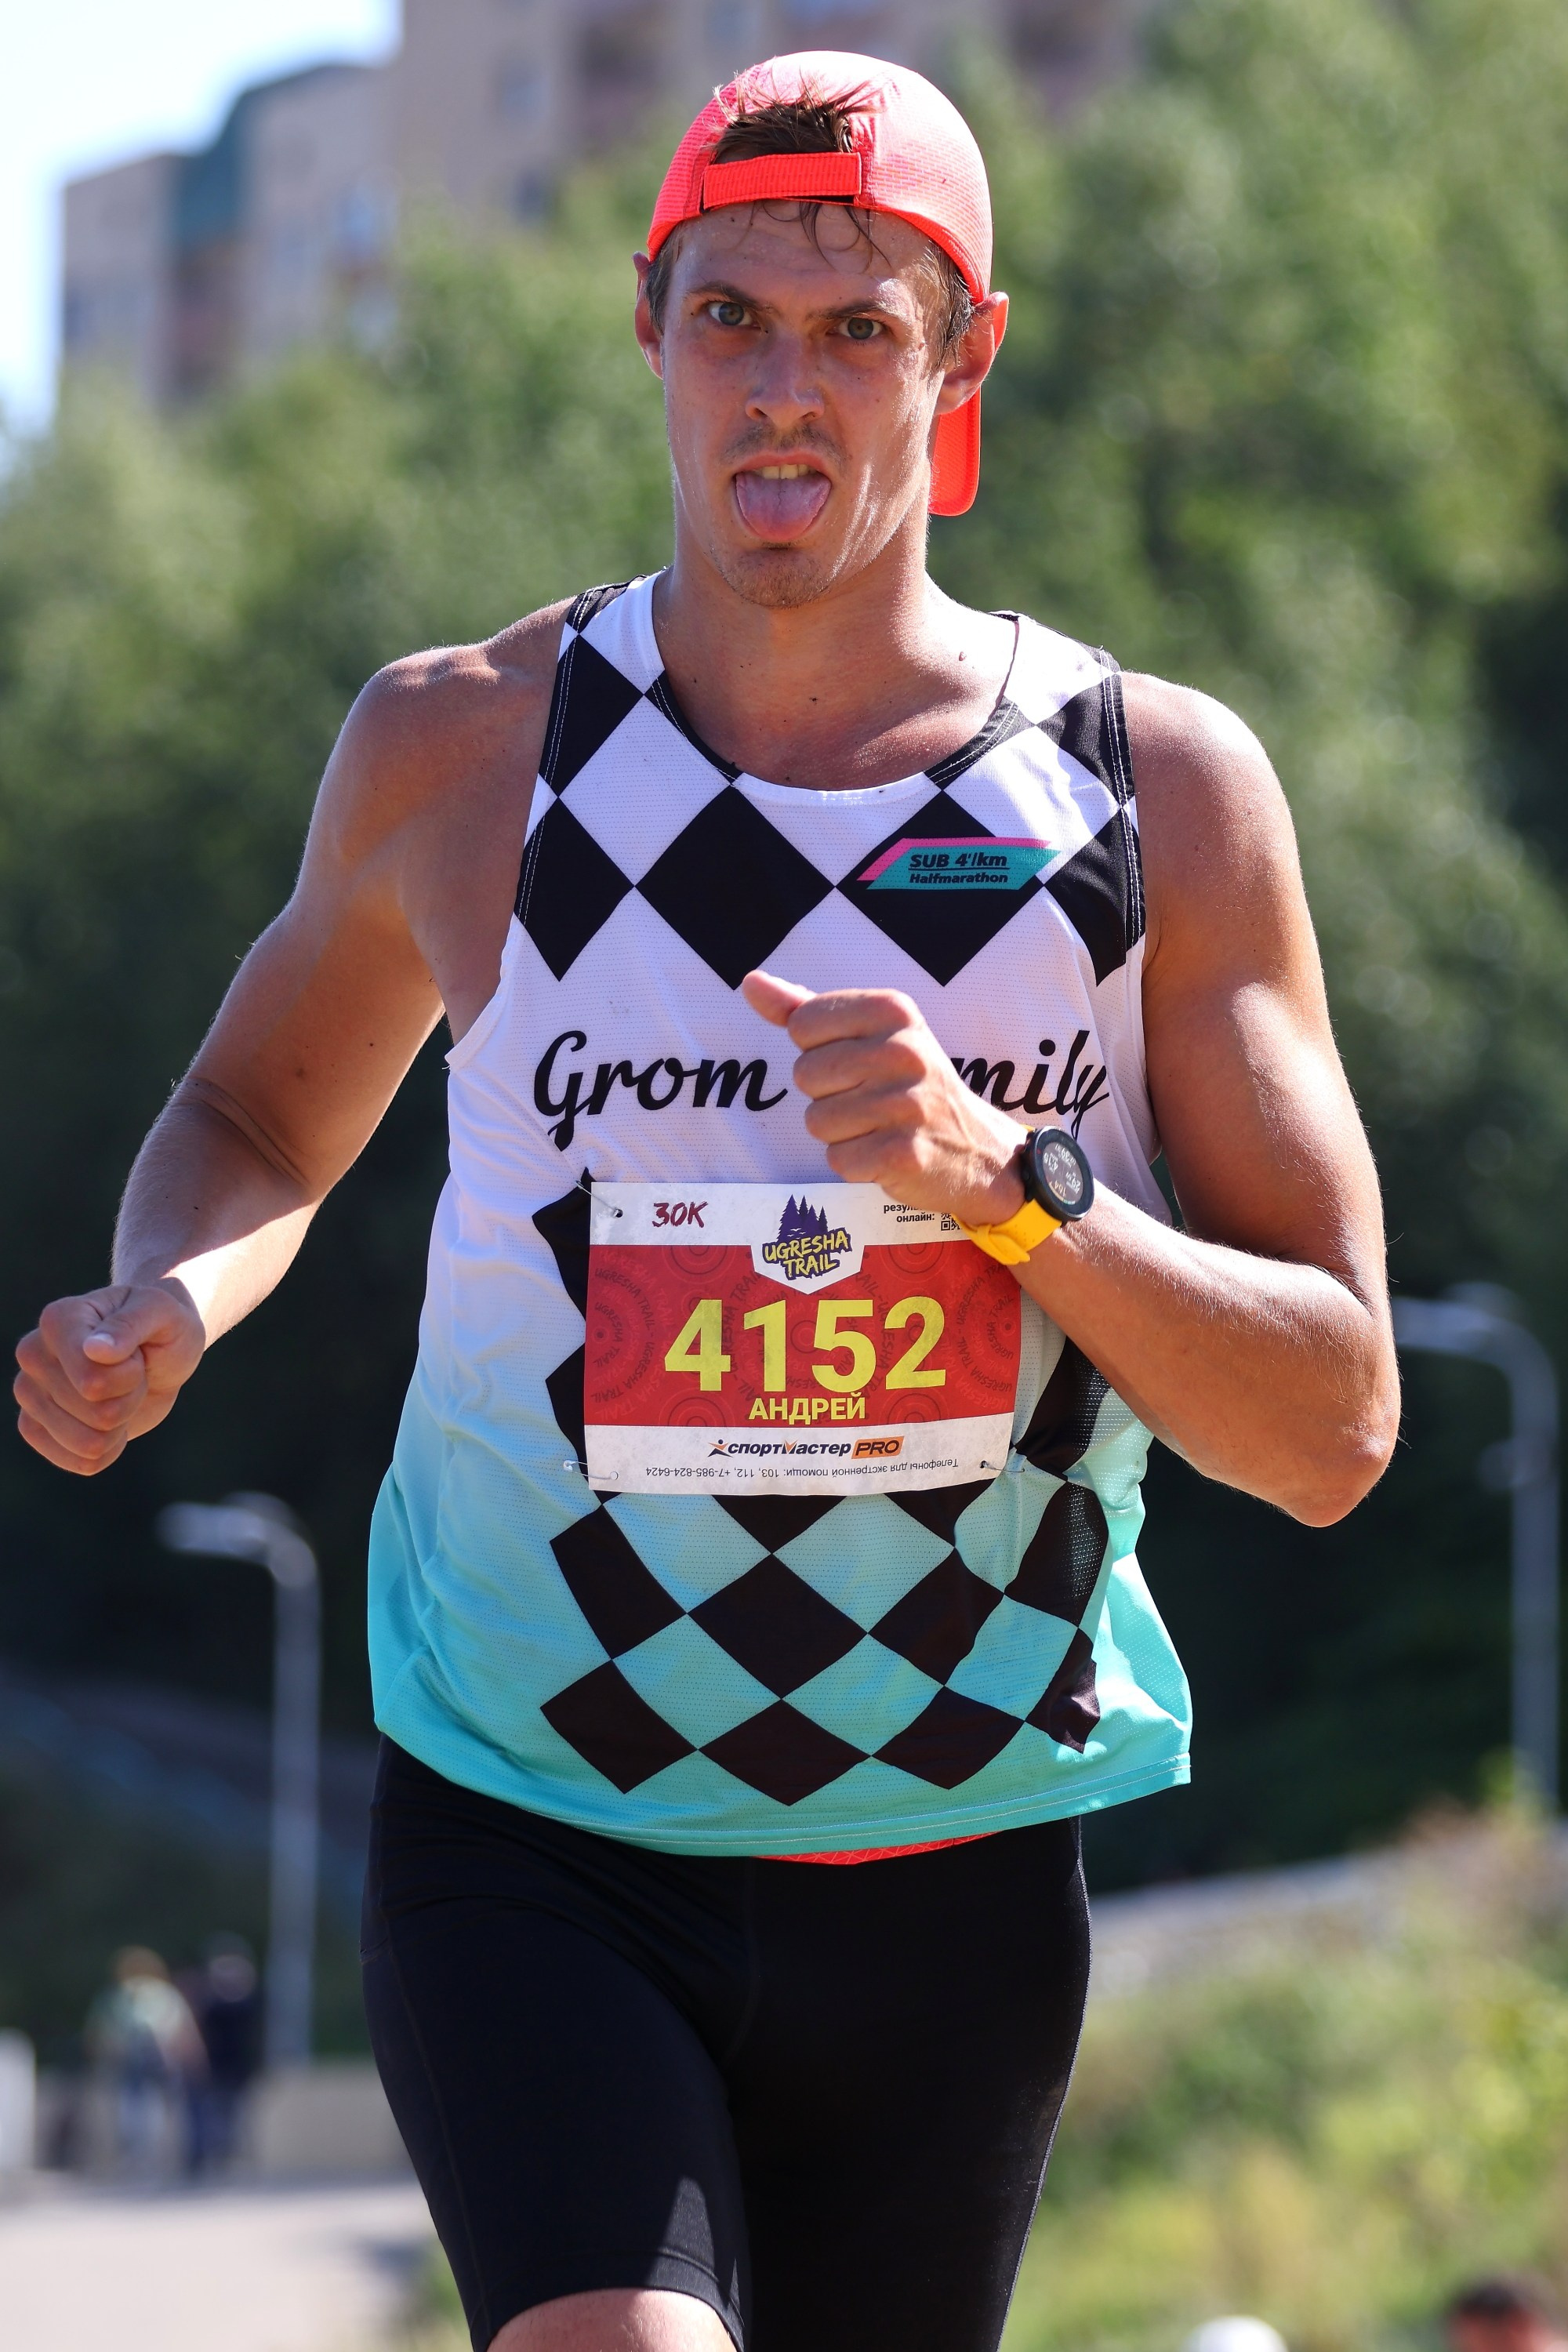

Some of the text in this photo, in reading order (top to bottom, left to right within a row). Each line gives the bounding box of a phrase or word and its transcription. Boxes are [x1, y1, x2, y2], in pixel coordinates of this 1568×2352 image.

[909, 854, 949, 868] SUB
[909, 872, 1008, 884] Halfmarathon
[534, 1029, 1110, 1152] Grom mily
[652, 1201, 709, 1229] 30K
[883, 1204, 923, 1214] резул
[896, 1211, 935, 1223] онлайн:
[764, 1230, 849, 1262] UGRESHA
[782, 1253, 838, 1279] TRAIL
[664, 1295, 946, 1393] 4152
[748, 1392, 866, 1425] АНДРЕЙ
[855, 1439, 900, 1456] PRO
[645, 1458, 959, 1478] Телефоны для экстренной помощи: 103, 112, +7-985-824-6424
